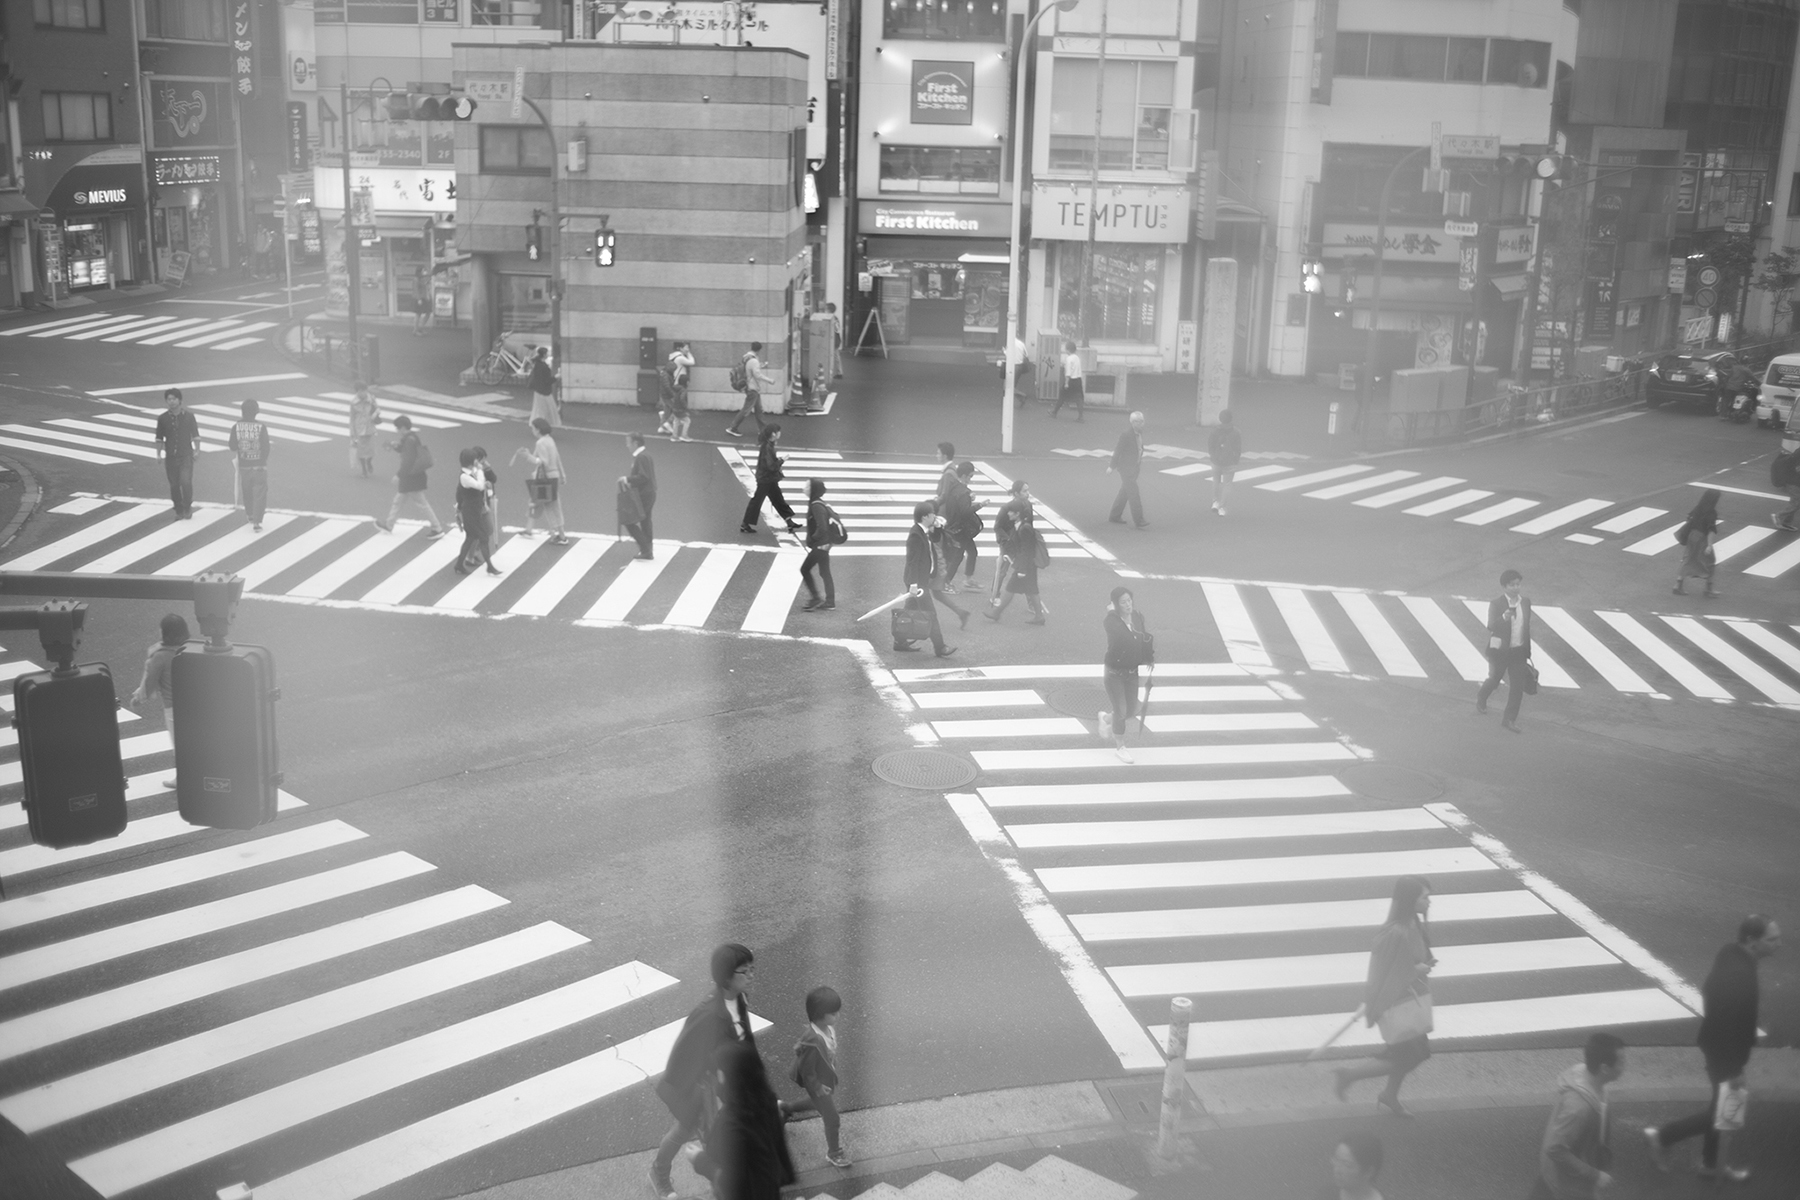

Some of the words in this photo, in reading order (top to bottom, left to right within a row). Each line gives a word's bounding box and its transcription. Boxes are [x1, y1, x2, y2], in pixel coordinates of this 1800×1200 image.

[236, 56, 252, 95] 餃子
[469, 82, 508, 94] 代々木駅
[927, 82, 958, 93] First
[916, 92, 968, 104] Kitchen
[1448, 138, 1495, 150] 代々木駅
[438, 150, 451, 159] 2F
[1677, 158, 1695, 209] HAIR
[88, 188, 127, 205] MEVIUS
[1057, 201, 1159, 229] TEMPTU
[1159, 204, 1168, 229] PRO
[875, 215, 914, 229] First
[916, 216, 979, 230] Kitchen
[1702, 272, 1716, 282] 40
[235, 423, 263, 432] AUGUST
[236, 431, 260, 440] BURNS
